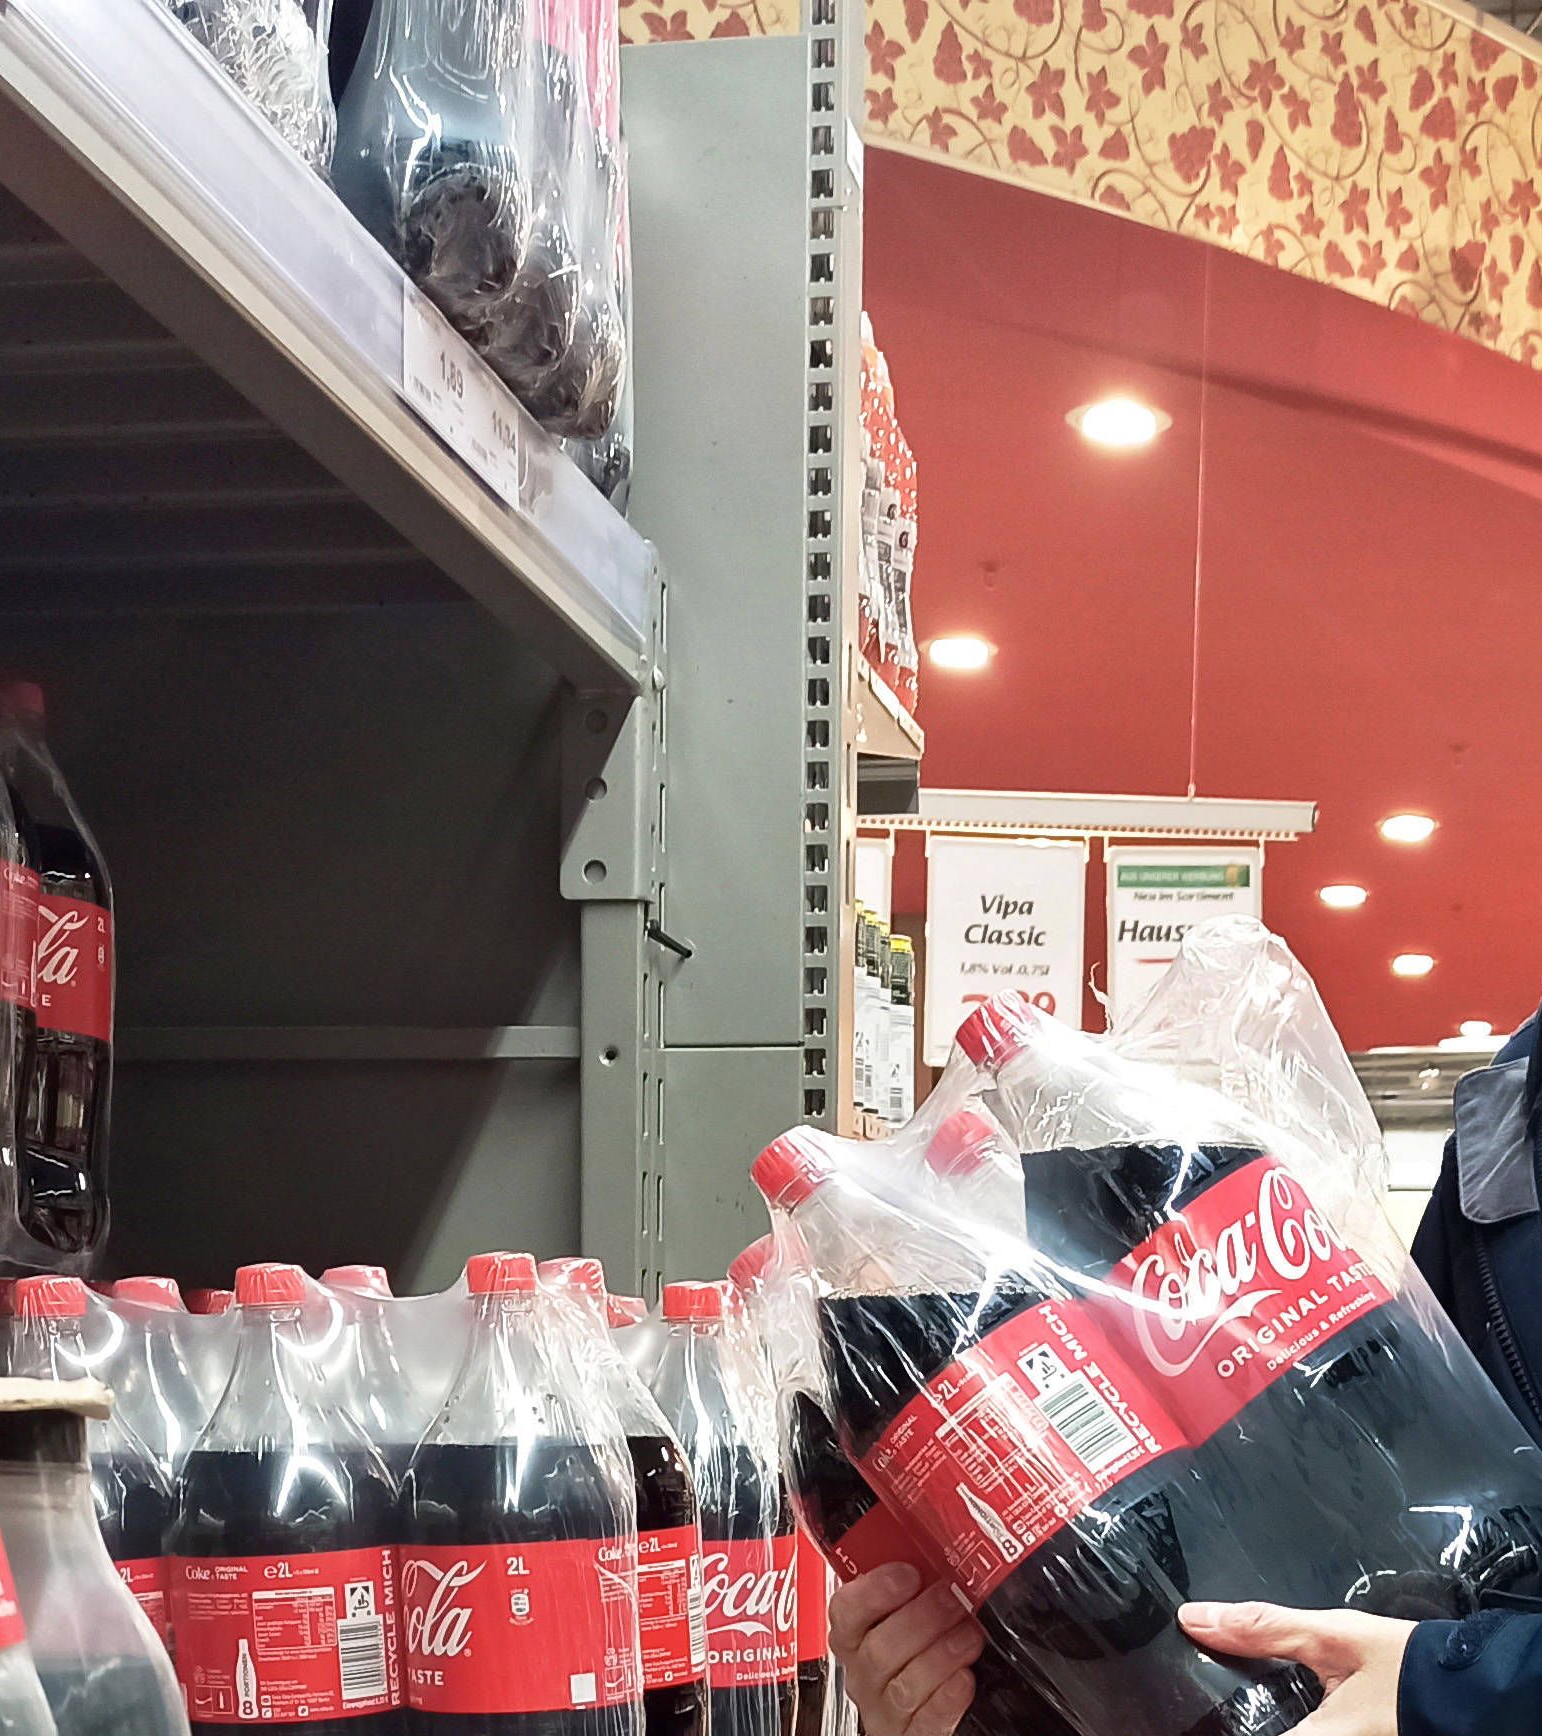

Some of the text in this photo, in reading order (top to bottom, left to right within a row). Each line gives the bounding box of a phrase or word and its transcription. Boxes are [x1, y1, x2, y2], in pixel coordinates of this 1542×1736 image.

[980, 893, 1034, 920] Vipa
[964, 924, 1047, 947] Classic
[1118, 919, 1195, 942] Haus
[1216, 1288, 1329, 1378] ORIGINAL
[1265, 1327, 1320, 1372] Delicious
[1037, 1305, 1163, 1454] RECYCLE MICH
[1000, 1538, 1018, 1557] 8
[185, 1565, 210, 1581] Coke
[506, 1556, 530, 1576] 2L
[381, 1549, 401, 1706] RECYCLE MICH
[707, 1646, 788, 1665] ORIGINAL
[408, 1669, 444, 1687] ASTE
[242, 1700, 254, 1716] 8
